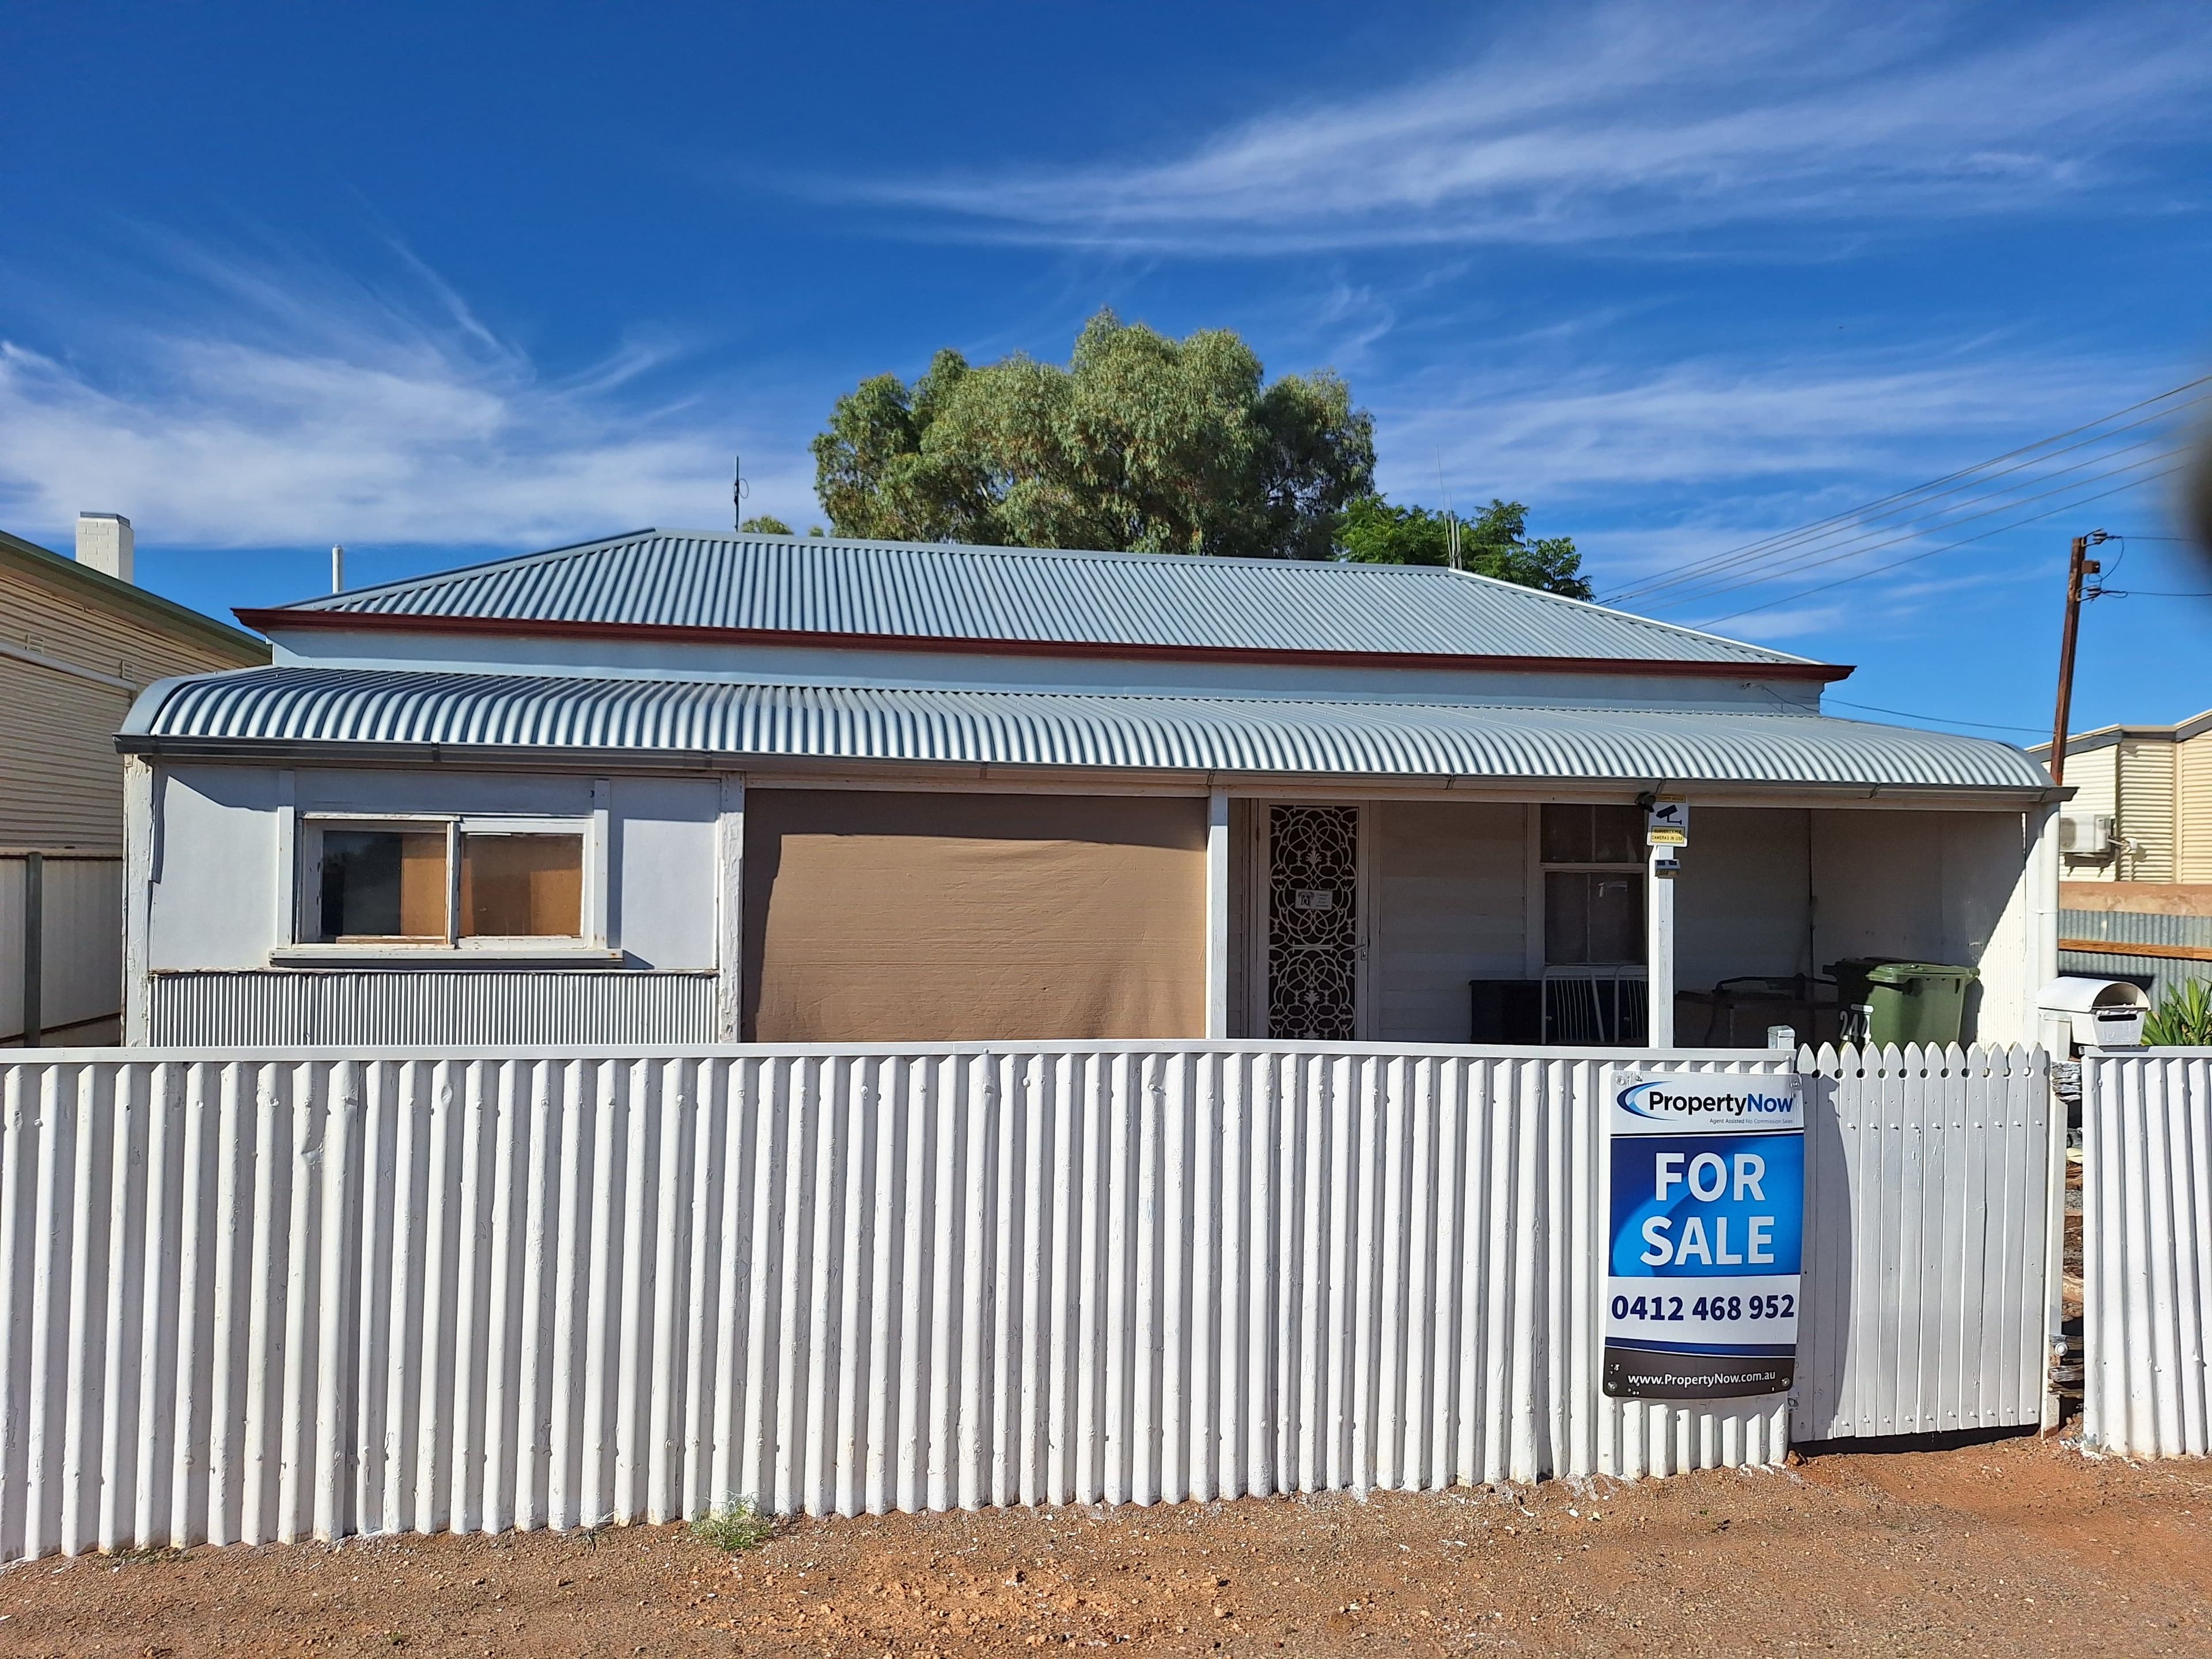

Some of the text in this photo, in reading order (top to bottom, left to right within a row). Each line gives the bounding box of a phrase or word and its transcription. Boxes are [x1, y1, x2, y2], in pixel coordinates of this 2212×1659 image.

[1649, 1091, 1793, 1116] PropertyNow
[1656, 1152, 1766, 1202] FOR
[1639, 1215, 1775, 1266] SALE
[1612, 1294, 1794, 1321] 0412 468 952
[1627, 1370, 1776, 1388] www.PropertyNow.com.au
